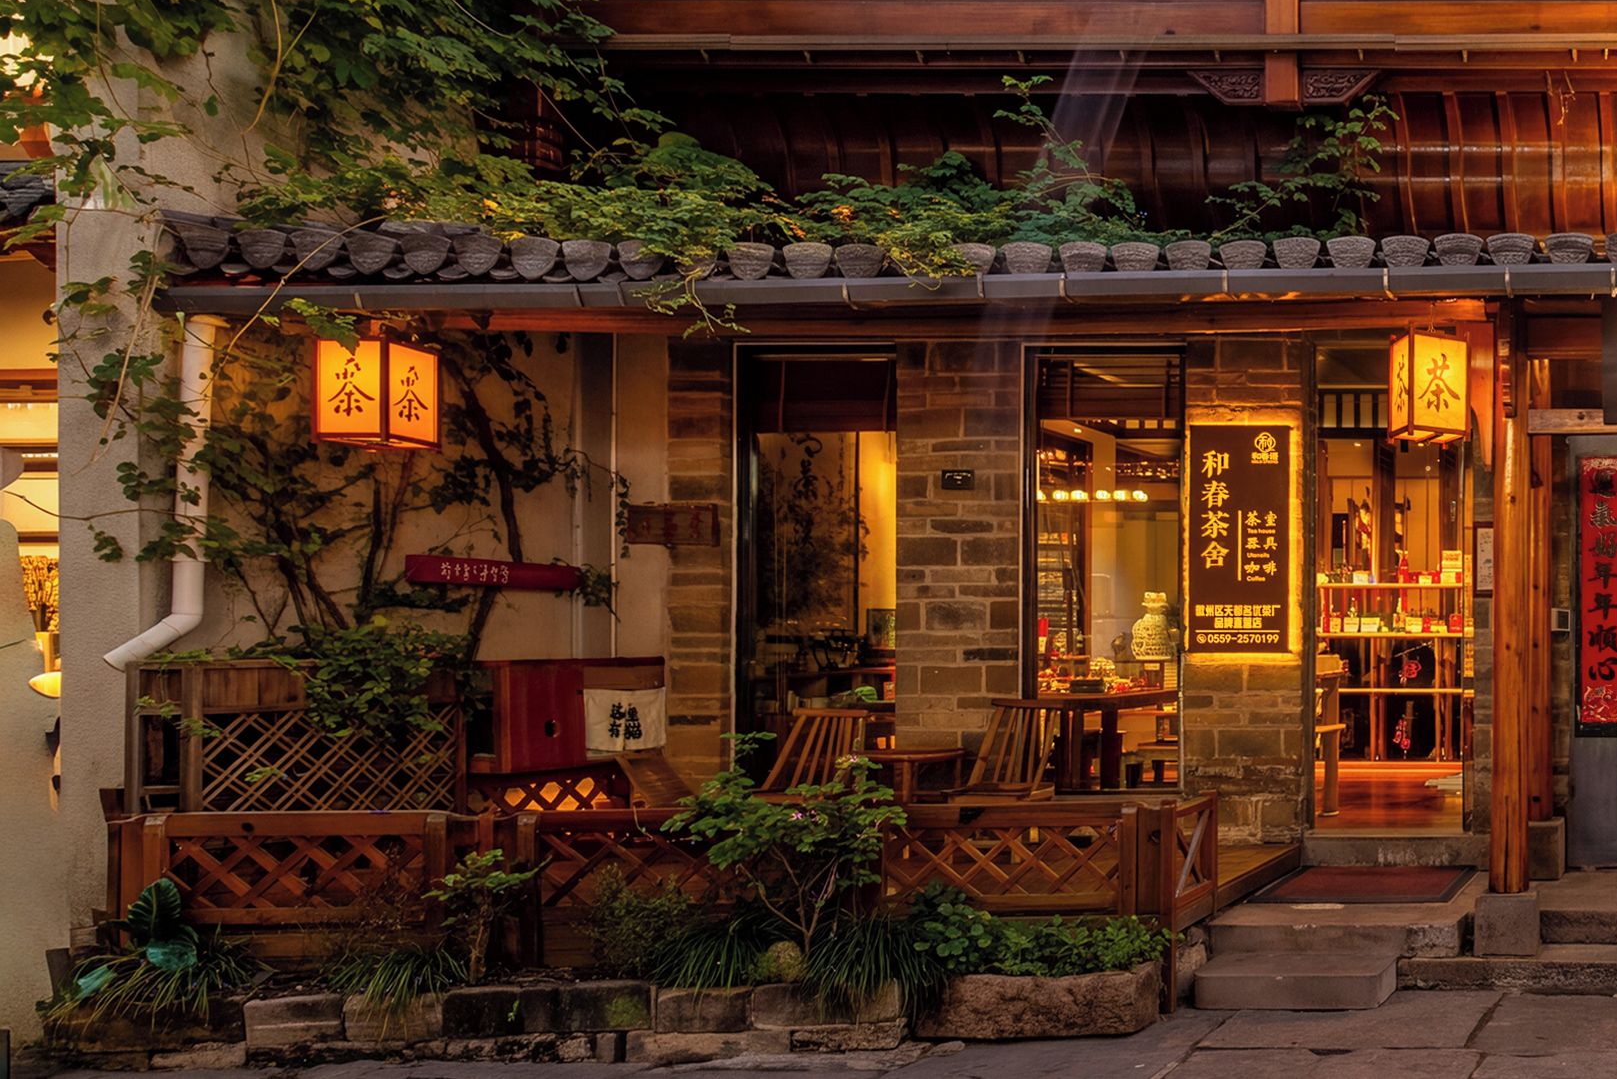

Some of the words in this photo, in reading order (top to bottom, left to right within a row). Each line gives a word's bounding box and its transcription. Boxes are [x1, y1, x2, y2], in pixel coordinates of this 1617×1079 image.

[328, 357, 375, 417] 茶
[393, 365, 428, 422] 茶
[1418, 353, 1461, 413] 茶
[1201, 450, 1230, 570] 和春茶舍
[1244, 510, 1277, 527] 茶室
[1244, 536, 1278, 550] 器具
[1243, 560, 1278, 576] 咖啡
[1207, 633, 1279, 643] 0559-2570199
